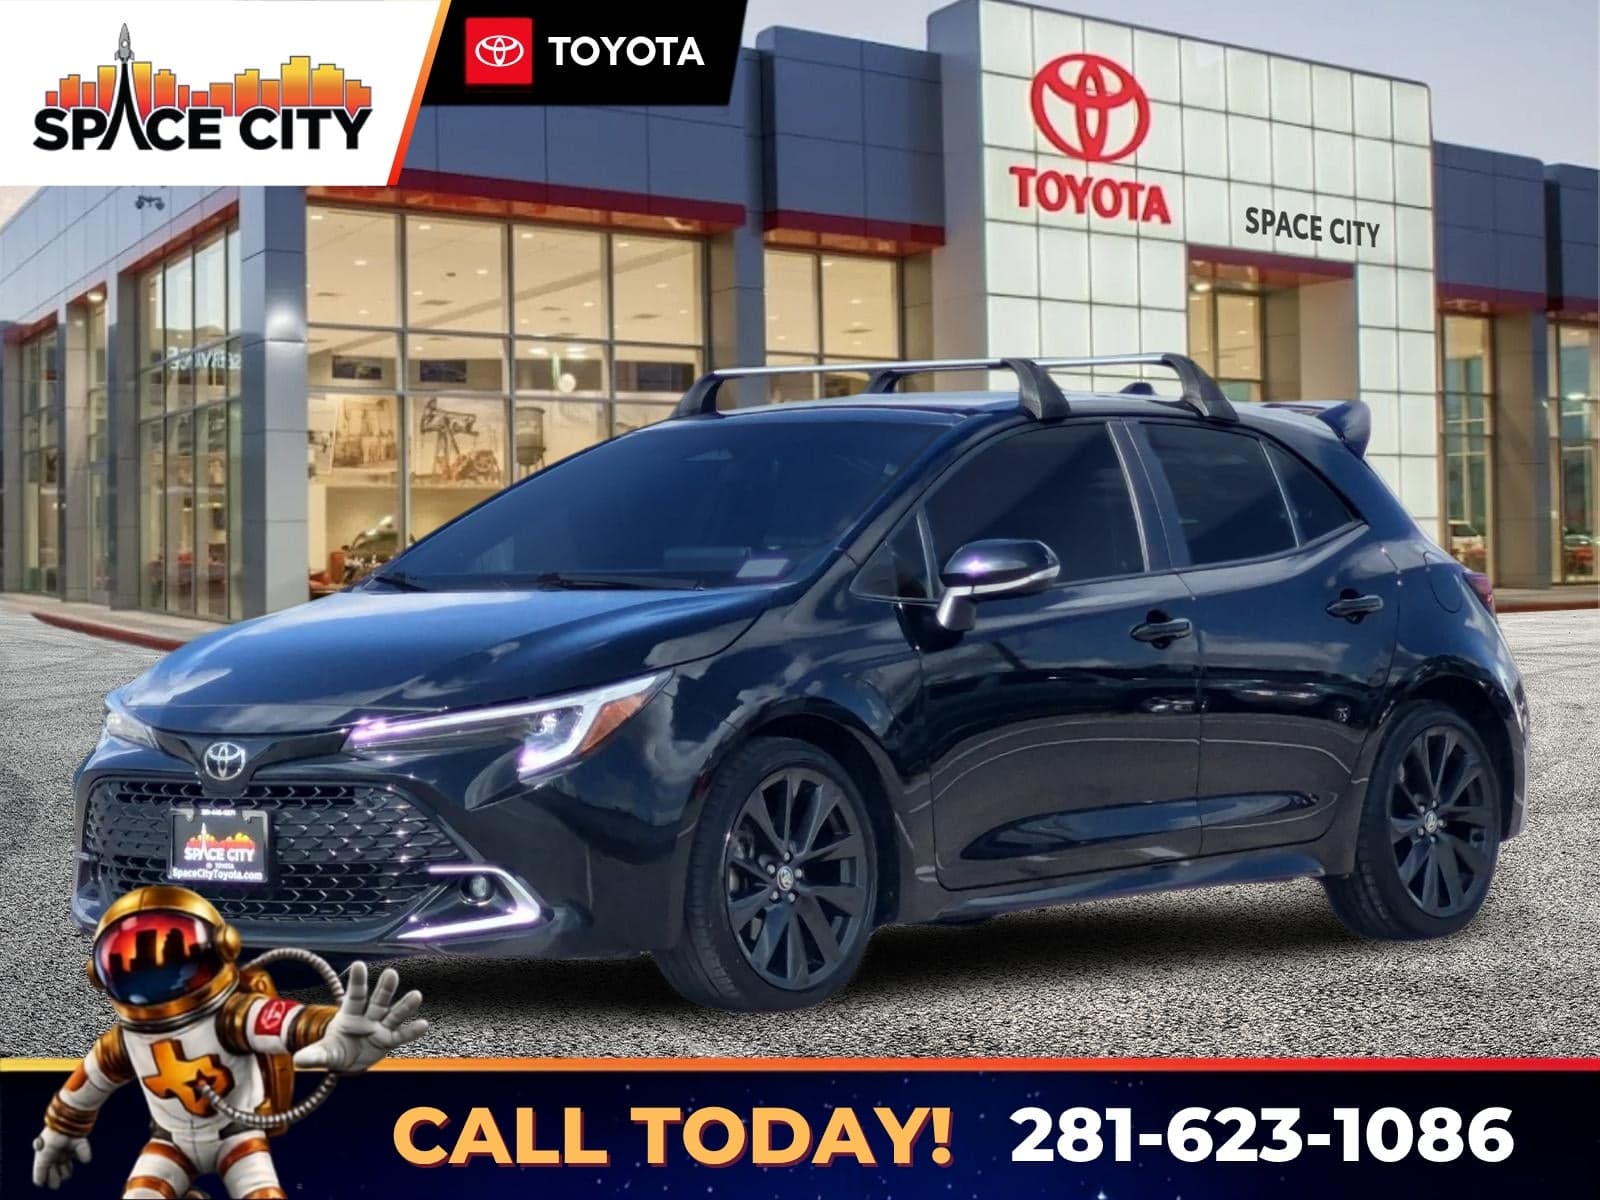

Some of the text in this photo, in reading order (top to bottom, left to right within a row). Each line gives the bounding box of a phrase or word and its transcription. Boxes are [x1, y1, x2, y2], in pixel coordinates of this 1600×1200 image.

[1009, 166, 1171, 224] TOYOTA
[1245, 206, 1380, 248] SPACE CITY
[184, 847, 255, 862] SPACE CITY
[172, 867, 263, 881] SpaceCityToyota.com
